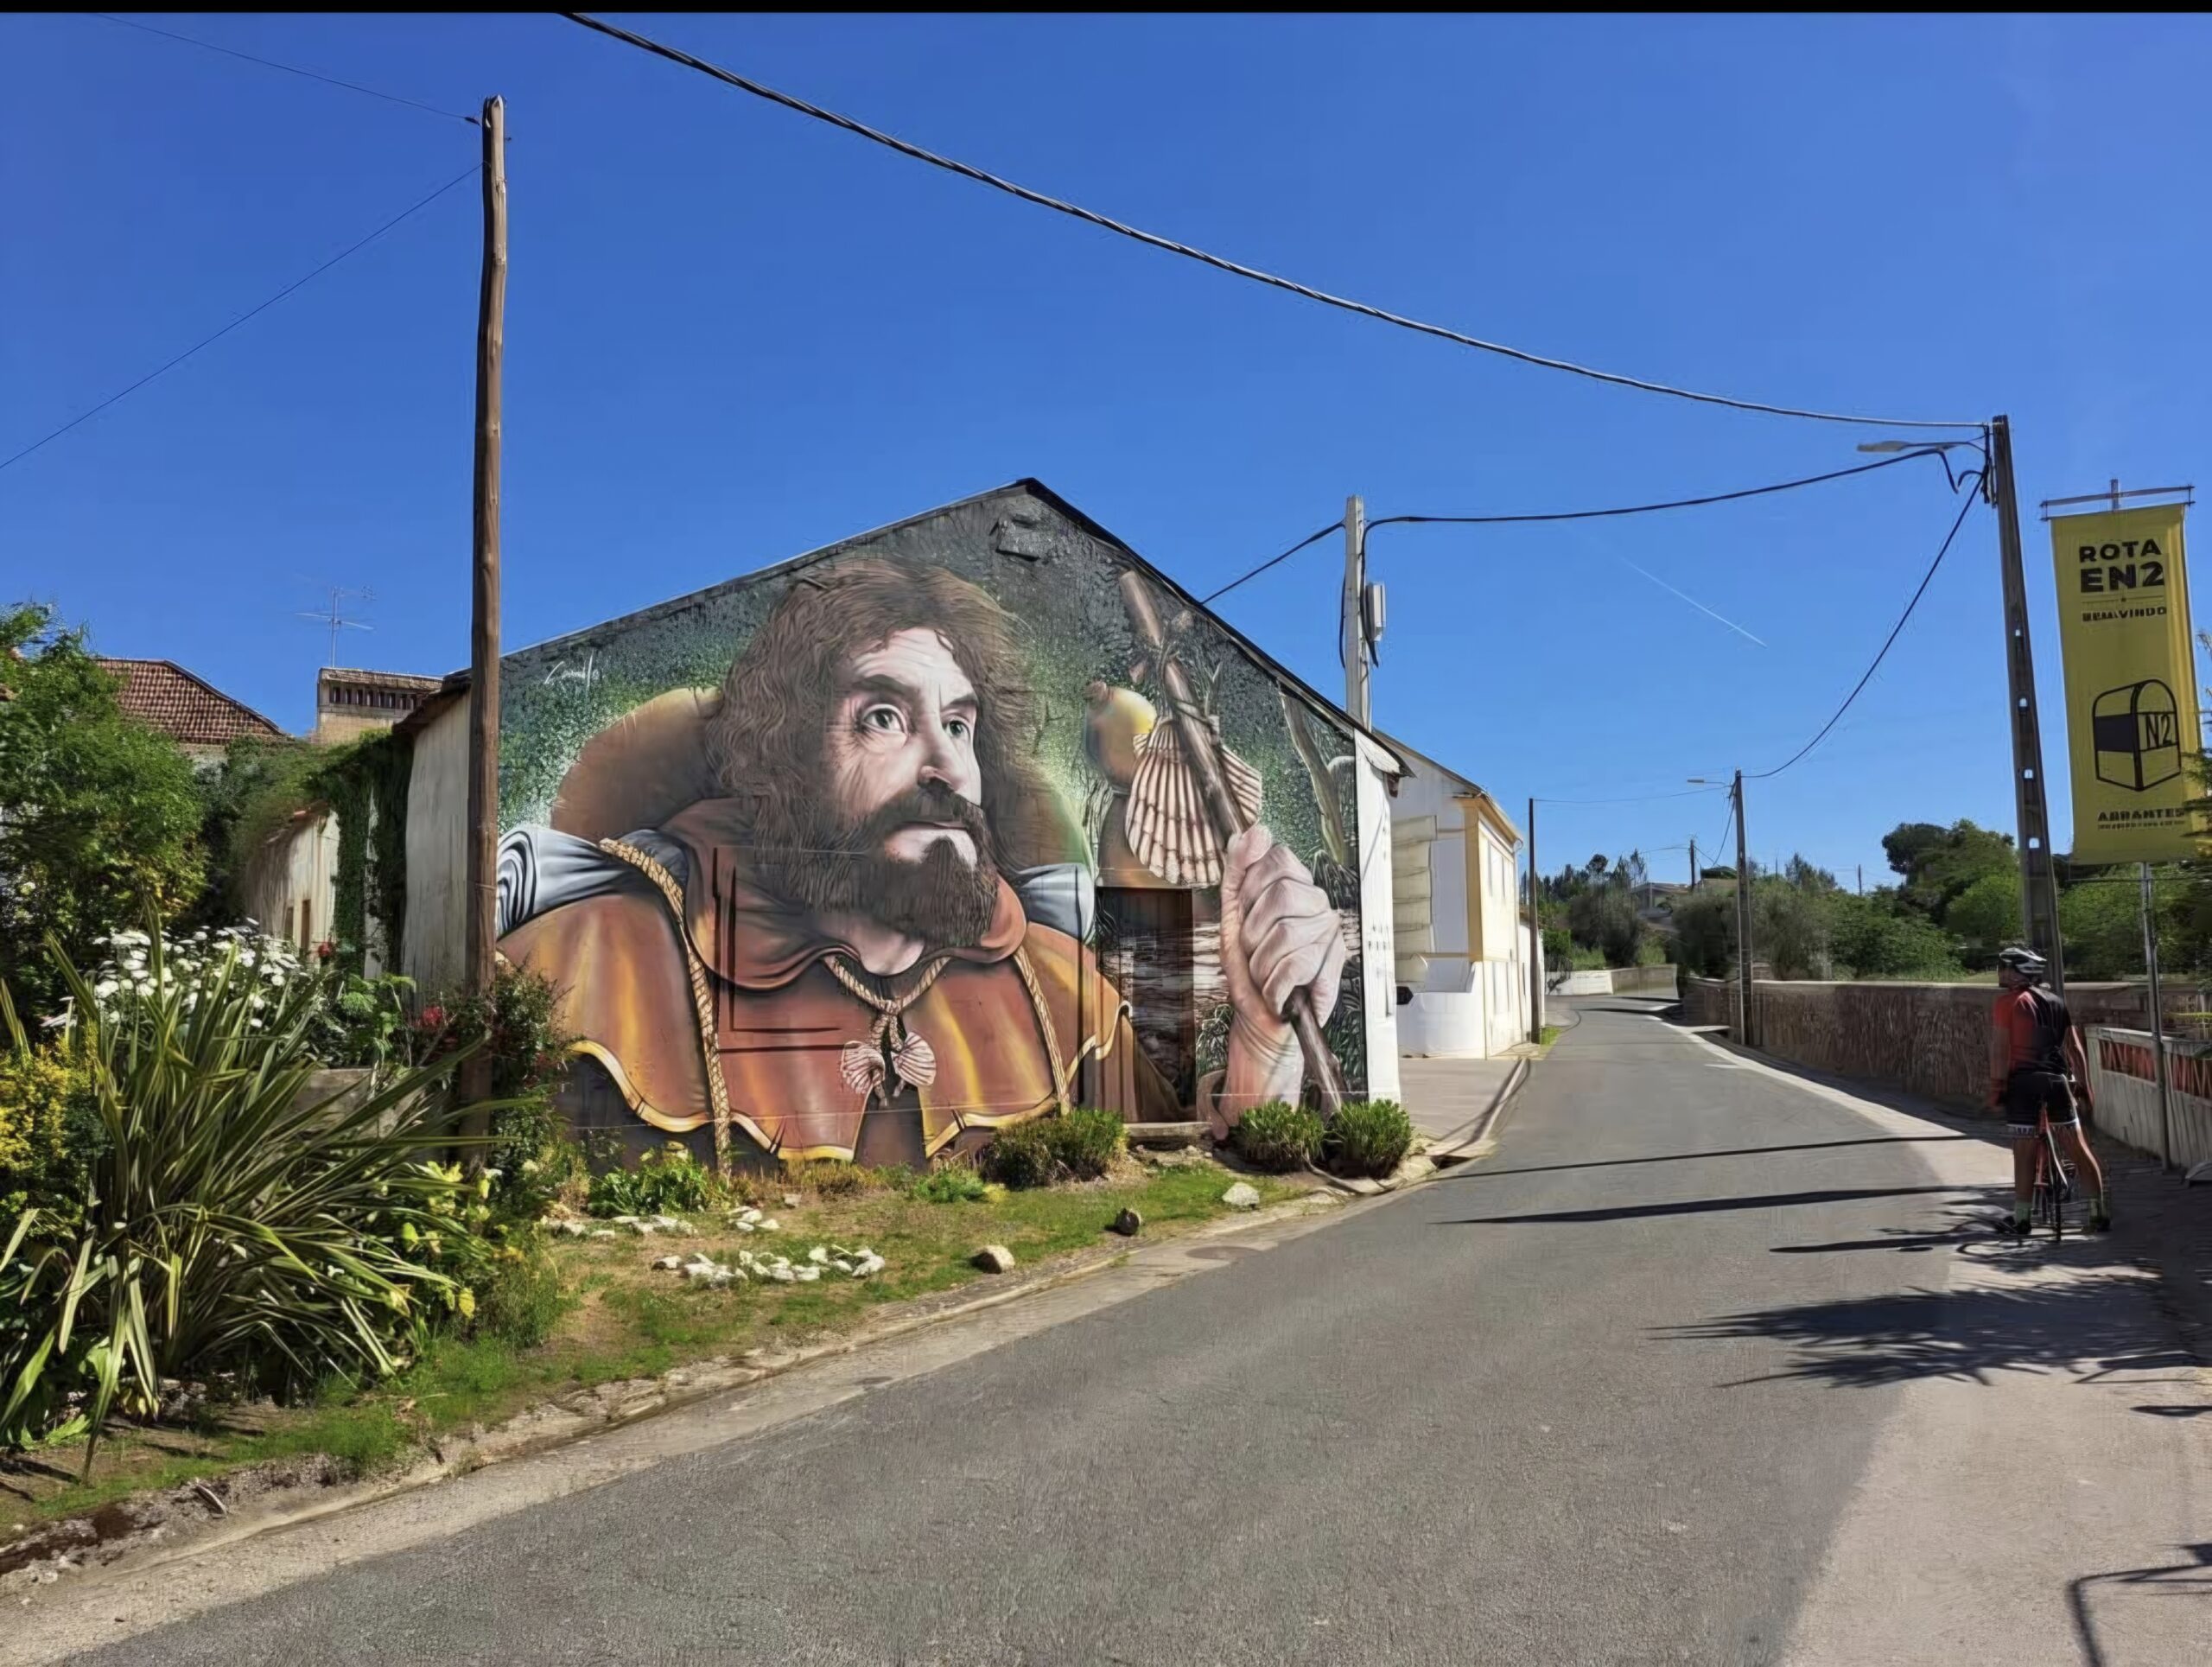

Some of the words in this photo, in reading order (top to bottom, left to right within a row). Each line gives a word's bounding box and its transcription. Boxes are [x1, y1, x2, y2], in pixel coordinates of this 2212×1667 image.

[2079, 539, 2162, 563] ROTA
[2081, 561, 2165, 593] EN2
[2145, 714, 2171, 748] N2
